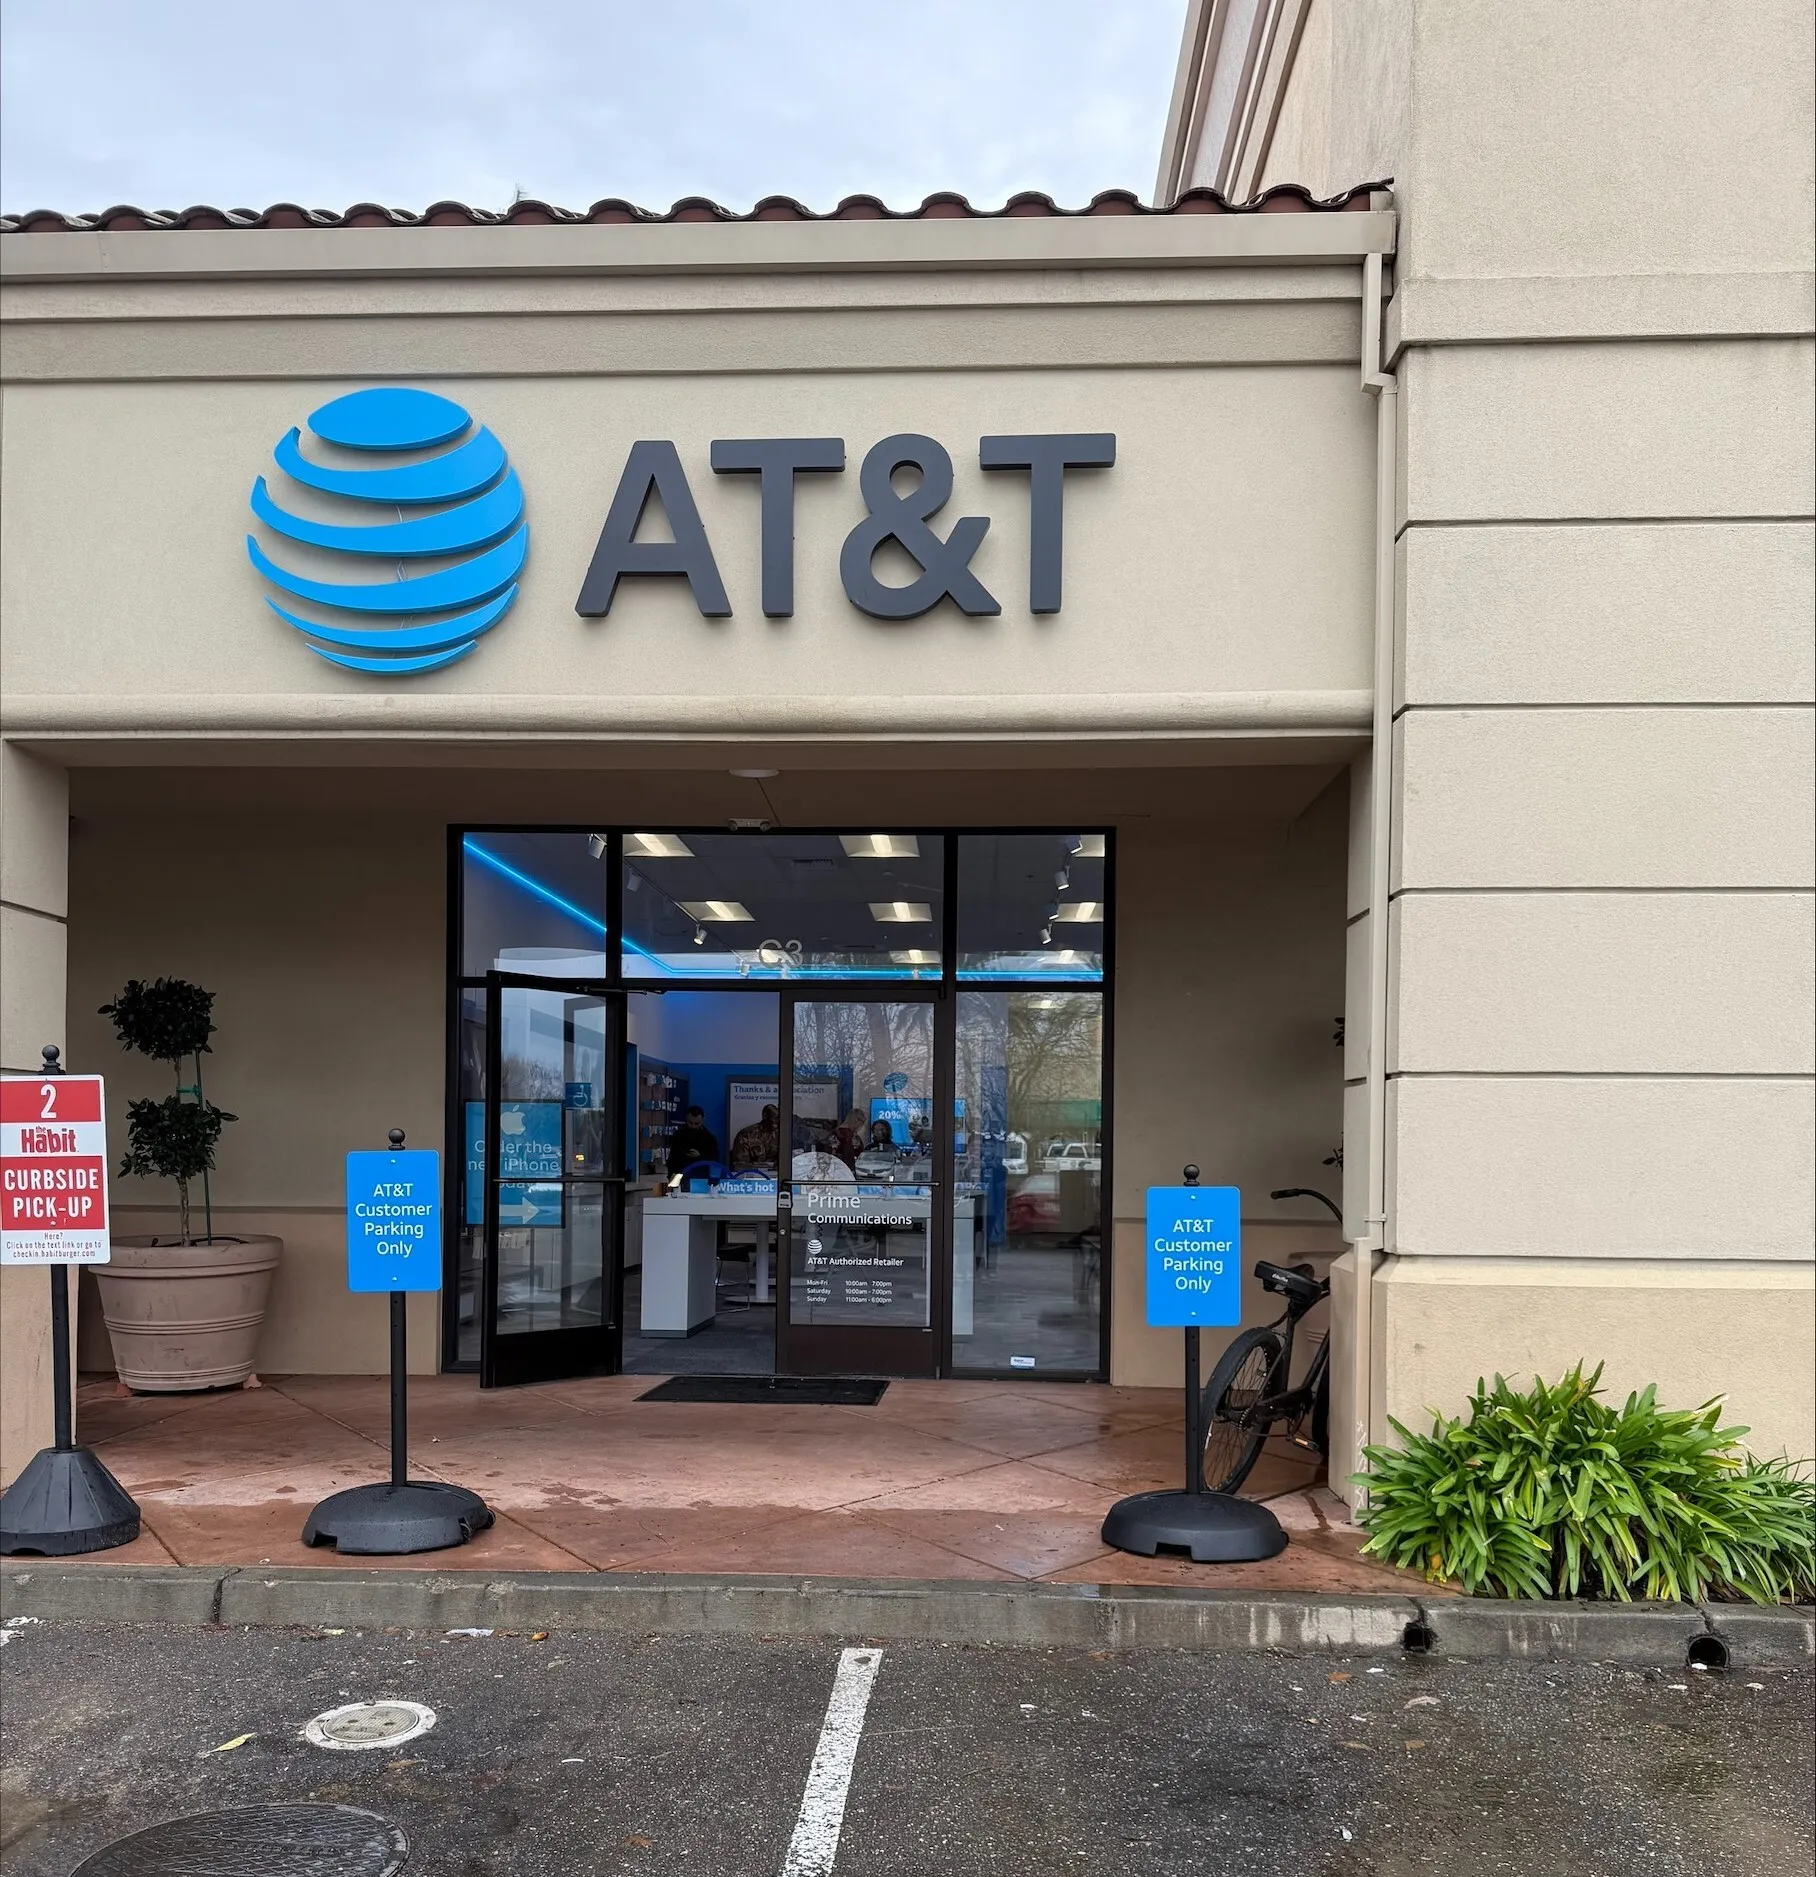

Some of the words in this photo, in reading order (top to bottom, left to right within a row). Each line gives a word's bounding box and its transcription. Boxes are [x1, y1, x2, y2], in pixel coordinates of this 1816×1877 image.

[575, 432, 1118, 621] AT&T
[758, 938, 803, 969] C3
[734, 1085, 764, 1093] Thanks
[773, 1086, 824, 1094] aciation
[40, 1083, 57, 1119] 2
[878, 1110, 901, 1120] 20%
[35, 1125, 47, 1133] the
[21, 1127, 77, 1153] Habit
[474, 1140, 522, 1153] Oder
[525, 1140, 552, 1153] the
[504, 1157, 559, 1171] iPhone
[4, 1168, 99, 1191] CURBSIDE
[718, 1182, 752, 1192] What's
[755, 1181, 775, 1192] hot
[373, 1183, 414, 1197] AT&T
[13, 1195, 93, 1218] PICK-UP
[808, 1192, 861, 1208] Prime
[355, 1203, 433, 1217] Customer
[807, 1213, 913, 1225] Communications
[1172, 1219, 1214, 1233] AT&T
[44, 1232, 63, 1240] Here?
[364, 1221, 424, 1239] Parking
[6, 1241, 23, 1249] Click
[47, 1241, 60, 1249] text
[85, 1242, 93, 1250] go
[376, 1241, 413, 1258] Only
[1154, 1238, 1233, 1252] Customer
[807, 1257, 828, 1265] AT&T
[829, 1257, 872, 1266] Authorized
[873, 1258, 904, 1267] Retailer
[1163, 1257, 1223, 1275] Parking
[1175, 1276, 1212, 1294] Only
